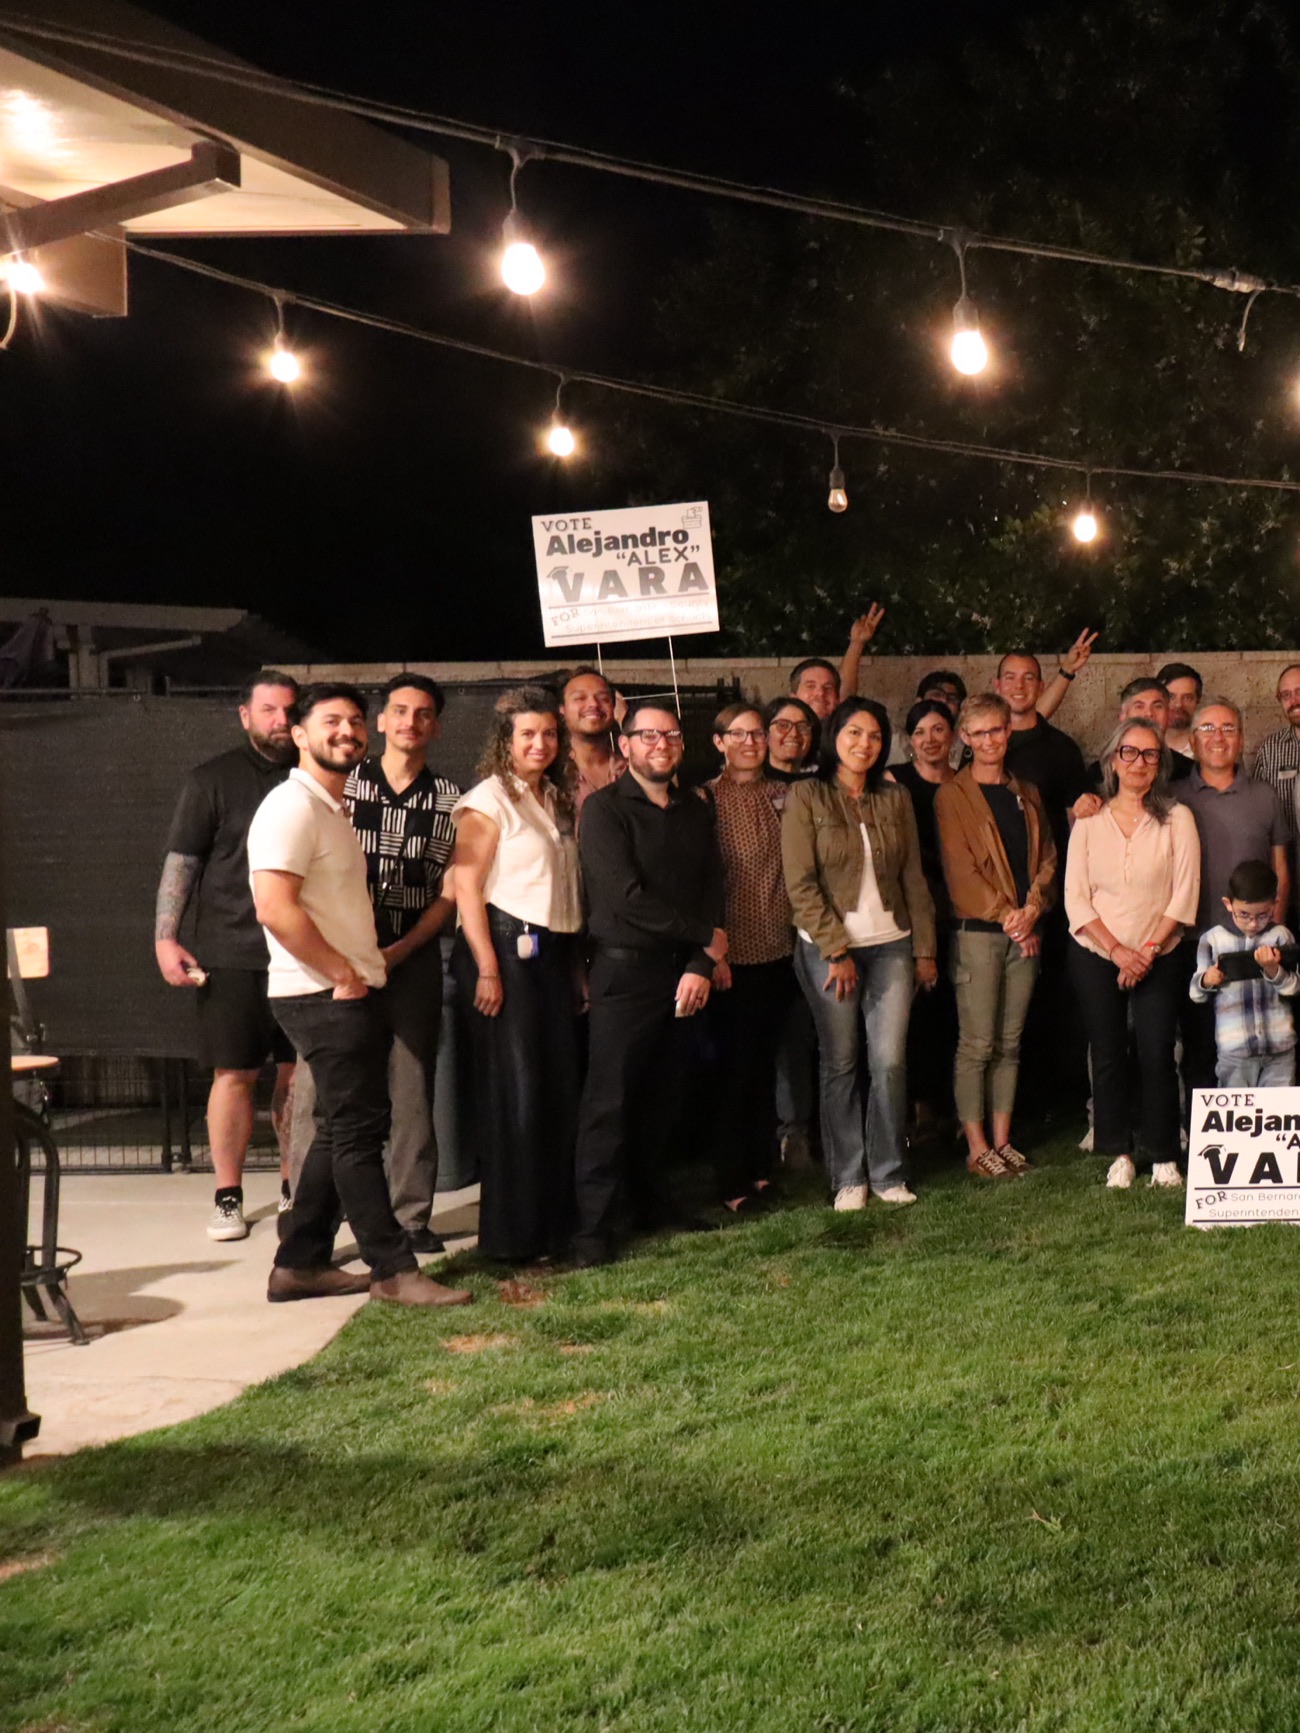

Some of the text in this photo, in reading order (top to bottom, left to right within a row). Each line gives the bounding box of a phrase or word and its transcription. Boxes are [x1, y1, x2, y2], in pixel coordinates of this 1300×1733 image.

[541, 517, 592, 532] VOTE
[546, 527, 689, 558] Alejandro
[548, 562, 709, 603] VARA
[551, 608, 579, 627] FOR
[1201, 1094, 1255, 1107] VOTE
[1195, 1191, 1228, 1210] FOR
[1231, 1192, 1254, 1202] San
